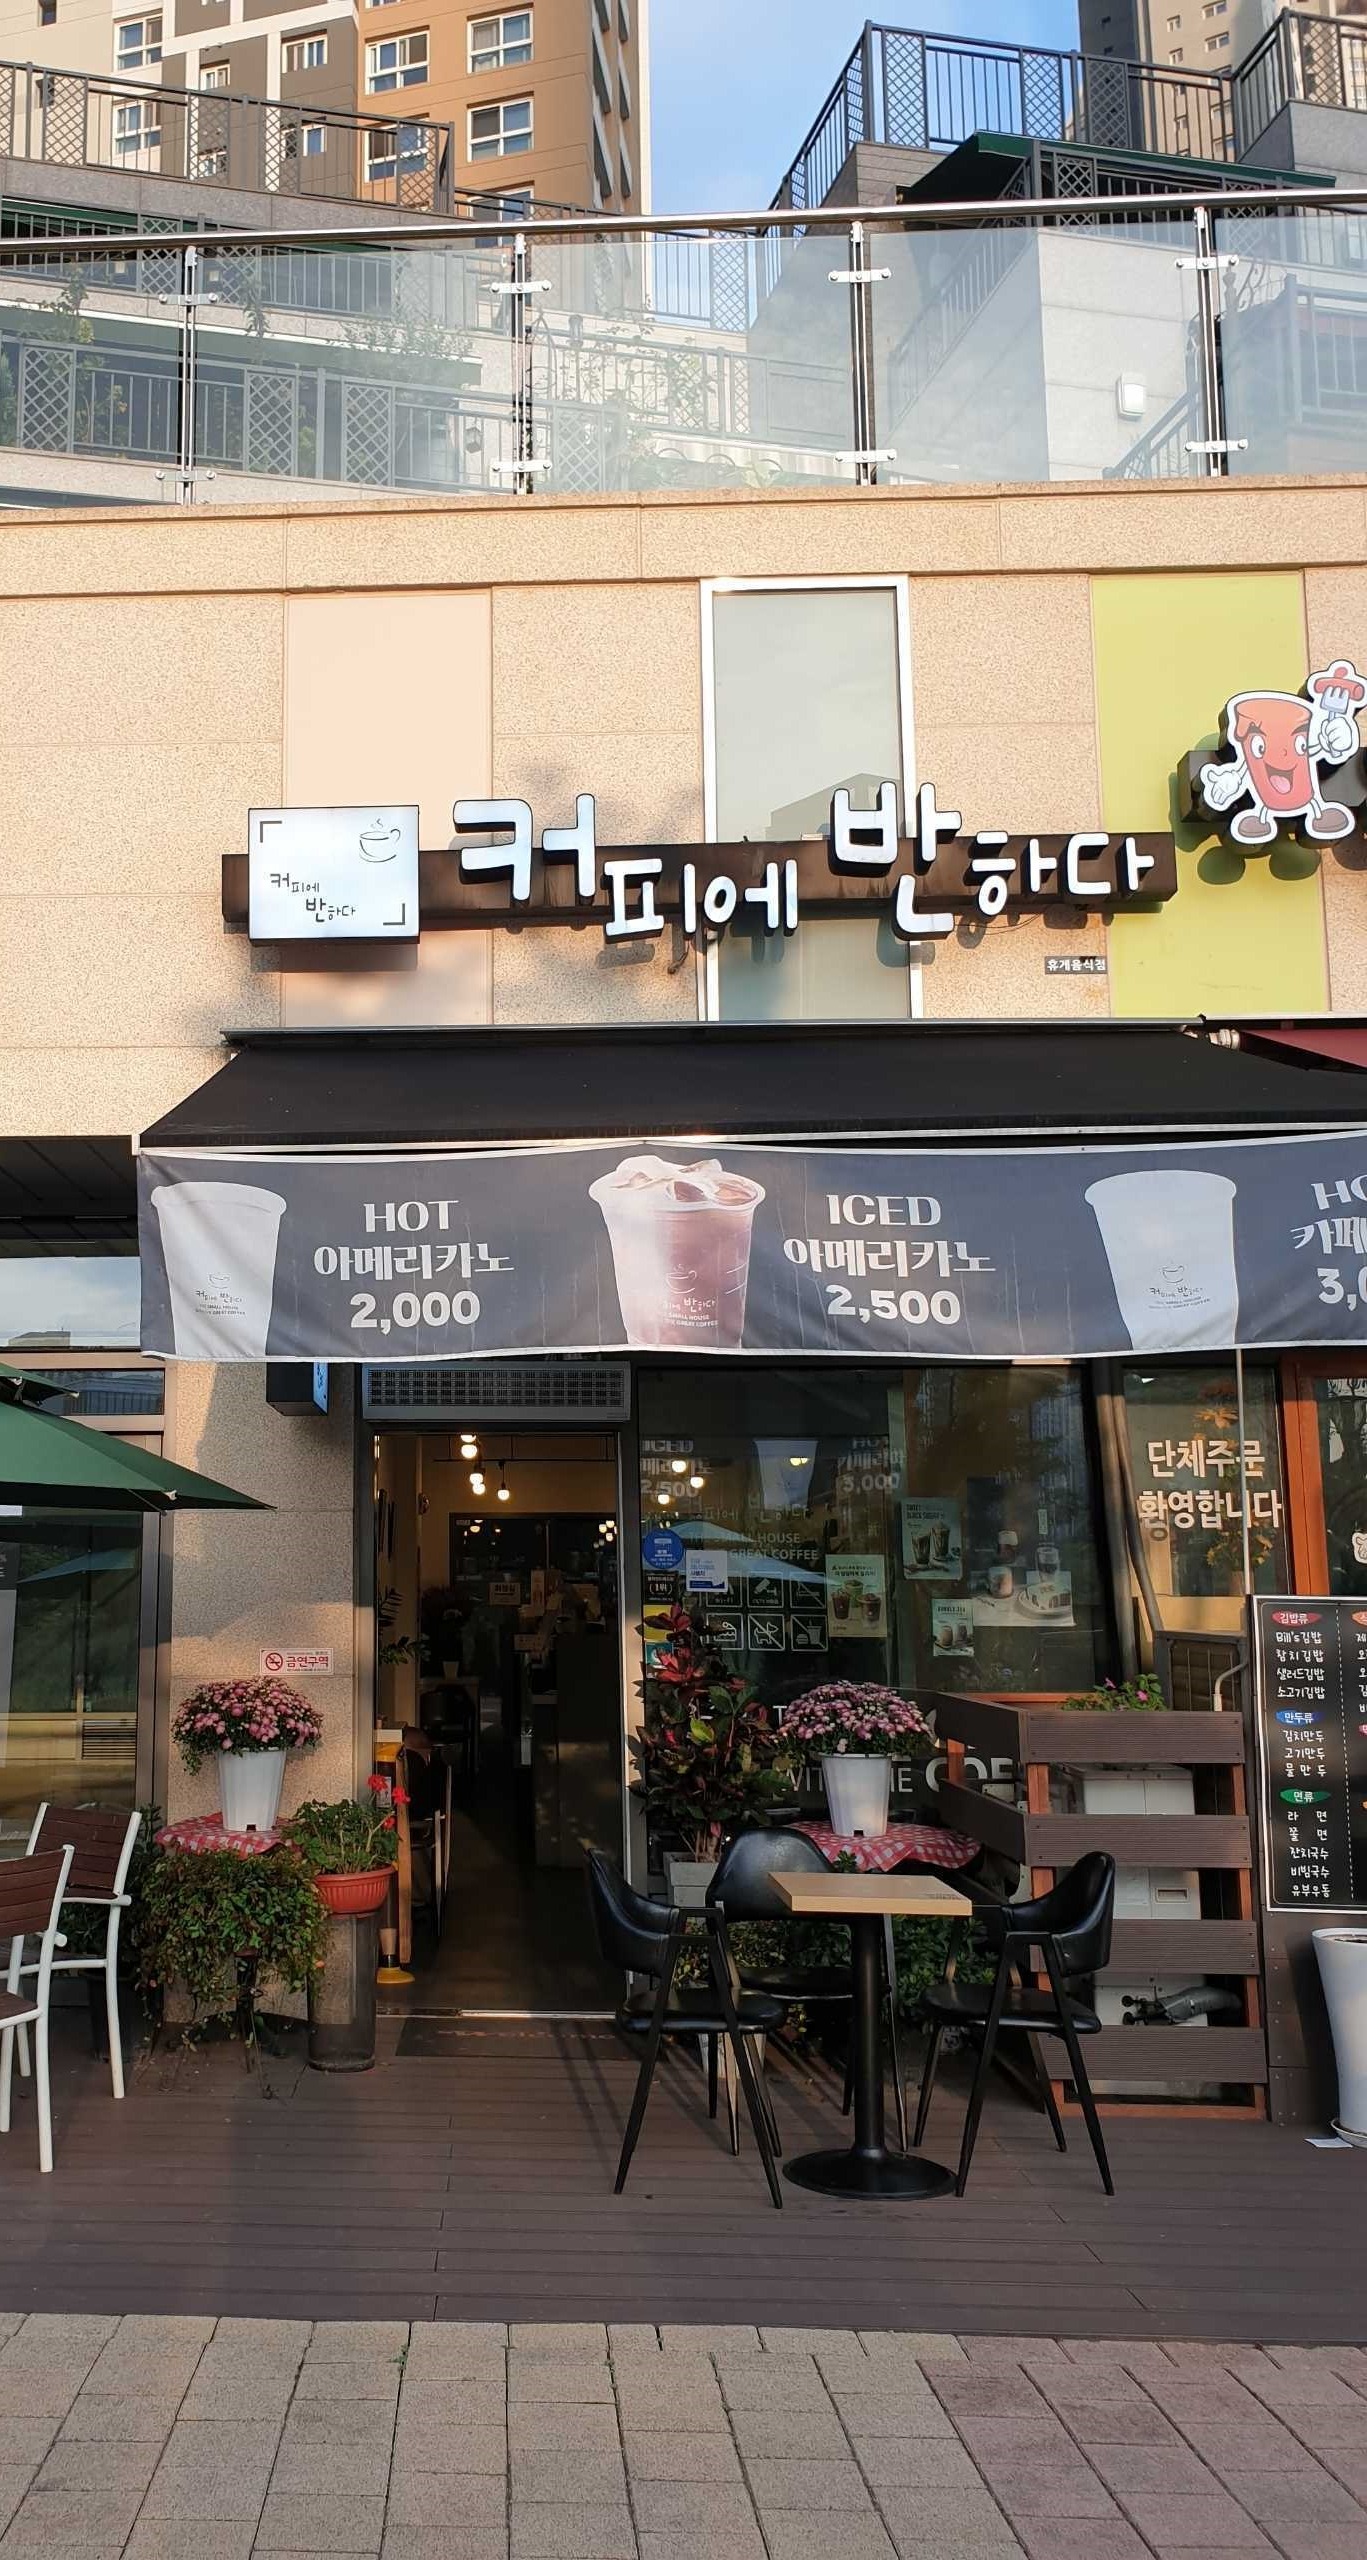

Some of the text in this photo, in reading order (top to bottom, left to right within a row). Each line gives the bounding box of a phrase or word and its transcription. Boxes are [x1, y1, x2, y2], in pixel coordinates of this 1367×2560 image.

[453, 780, 1155, 937] 커피에 반하다
[269, 872, 320, 893] 커피에
[305, 897, 356, 922] 반하다
[363, 1199, 459, 1233] HOT
[826, 1193, 943, 1227] ICED
[313, 1242, 515, 1281] 아메리카노
[783, 1238, 997, 1278] 아메리카노
[350, 1290, 481, 1336] 2,000
[824, 1283, 961, 1326] 2,500
[1147, 1439, 1266, 1478] 단체주문
[1138, 1489, 1283, 1530] 환영합니다
[285, 1655, 329, 1668] 금연구역
[1277, 1685, 1326, 1700] 소고기김밥
[1284, 1712, 1314, 1725] 만두류
[1283, 1729, 1325, 1743] 김치만두
[1284, 1747, 1326, 1760] 고기만두
[1290, 1846, 1329, 1860] 잔치국수
[1290, 1864, 1330, 1879] 비빔국수
[1291, 1883, 1331, 1898] 유부우동
